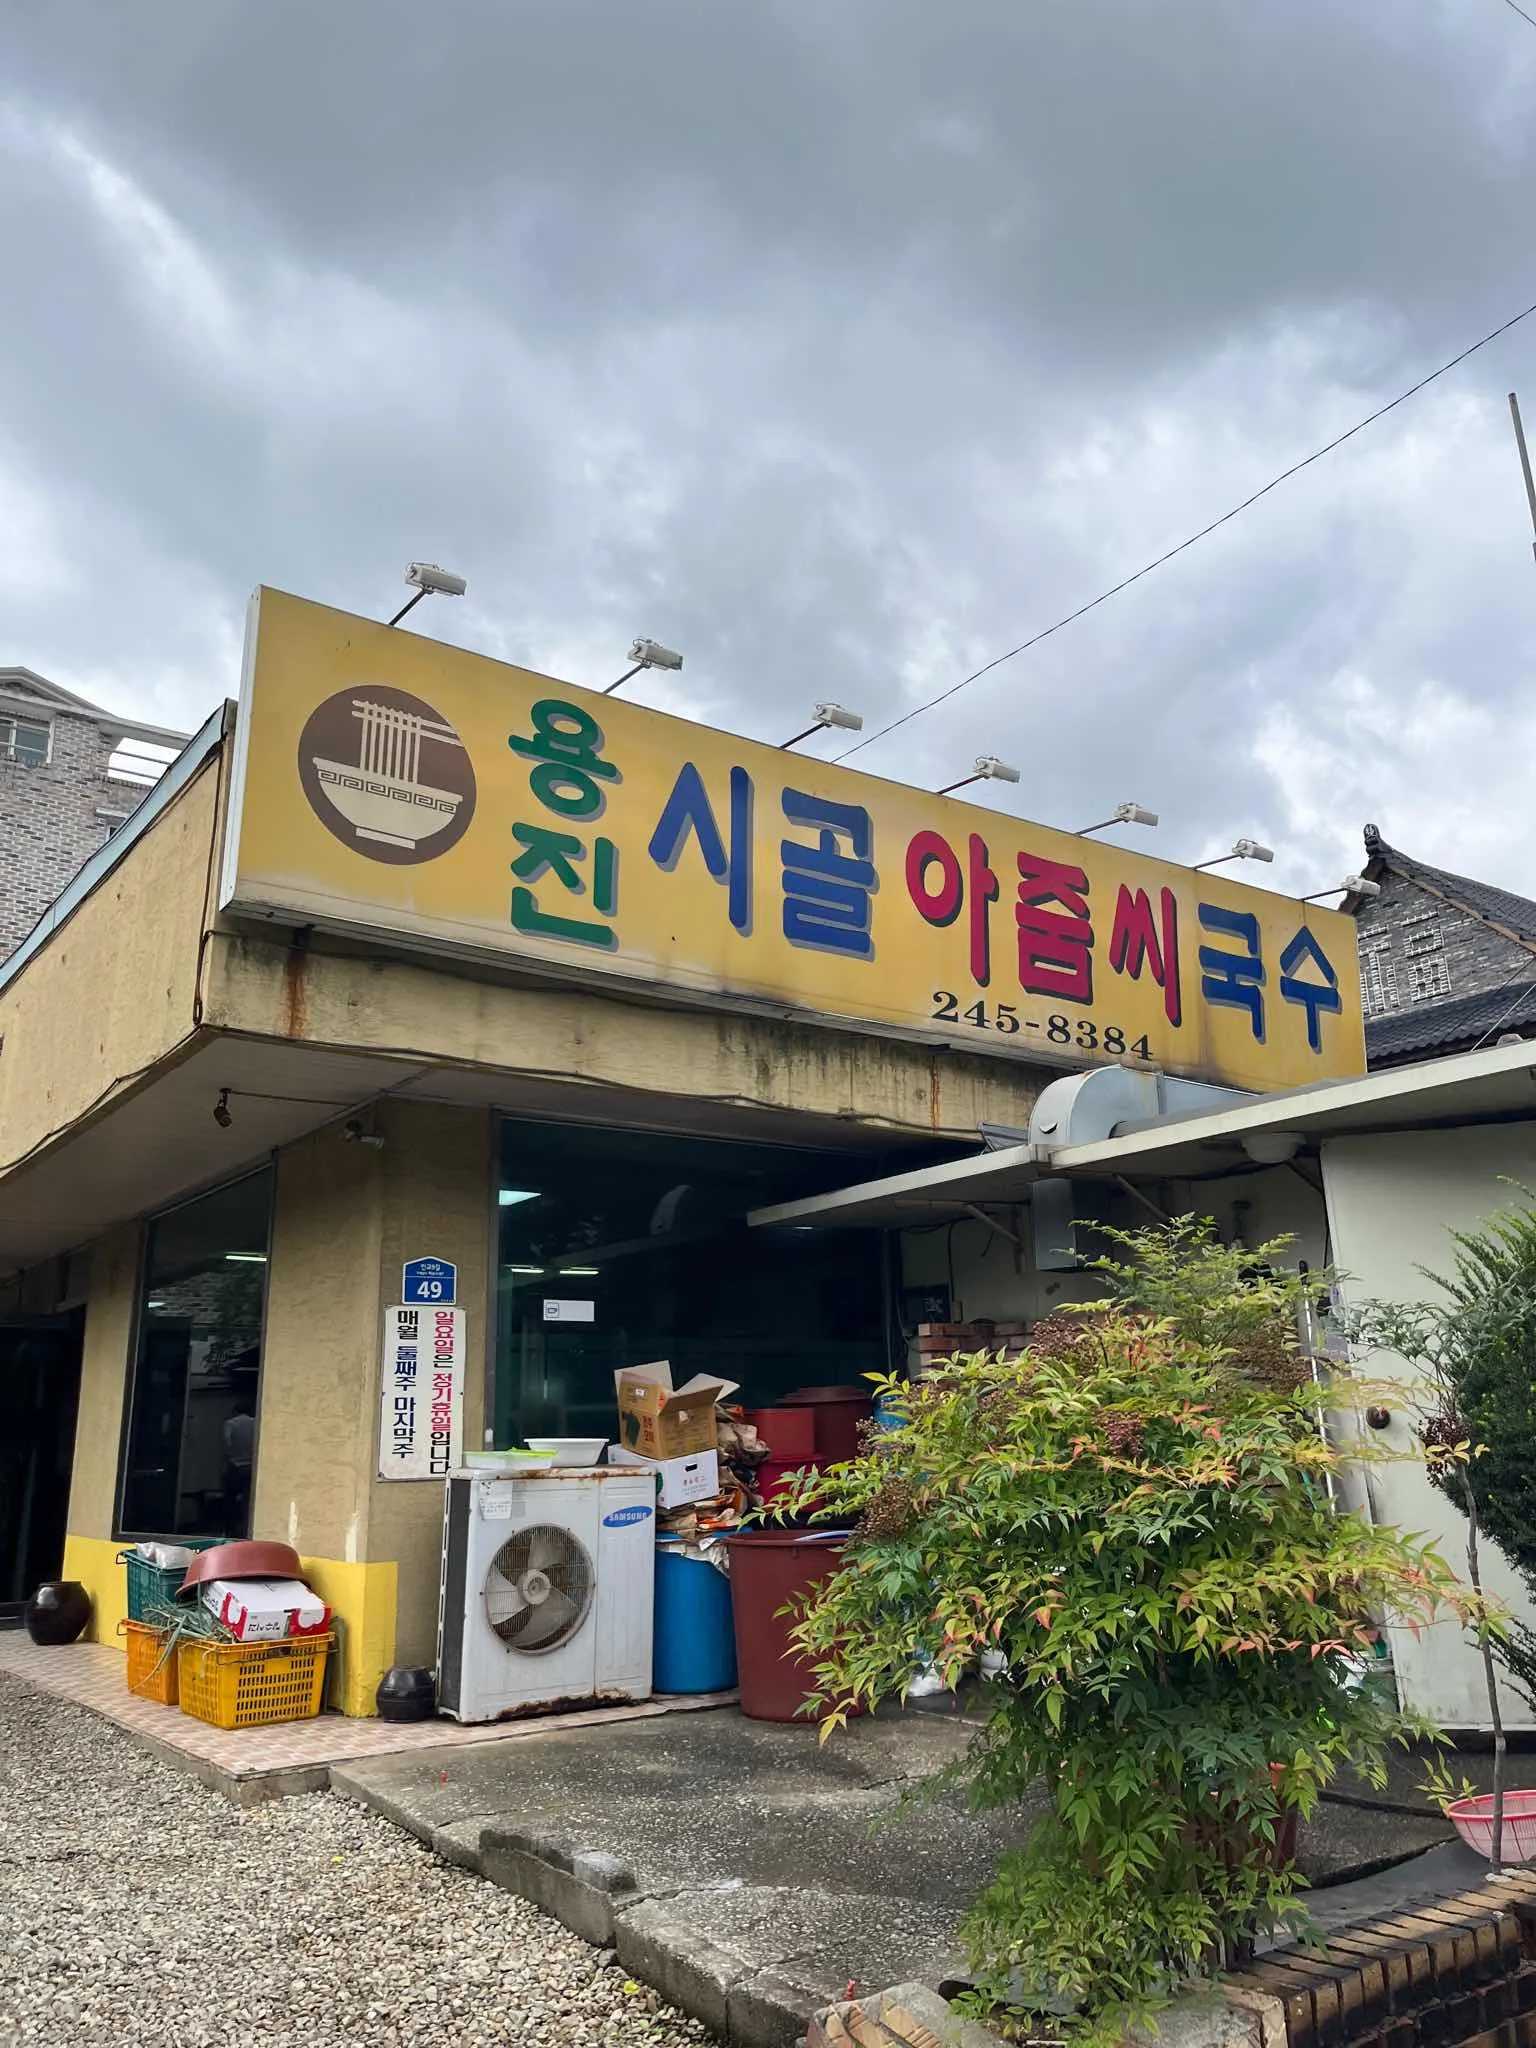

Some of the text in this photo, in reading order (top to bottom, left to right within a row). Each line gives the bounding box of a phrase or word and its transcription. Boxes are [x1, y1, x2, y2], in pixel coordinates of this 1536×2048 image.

[508, 699, 621, 952] 용진
[932, 991, 1153, 1061] 245-8384
[417, 1280, 442, 1298] 49
[433, 1311, 454, 1368] 일요일은
[392, 1310, 419, 1459] 매월 둘째주 마지막주
[430, 1373, 454, 1475] 정기휴일입니다
